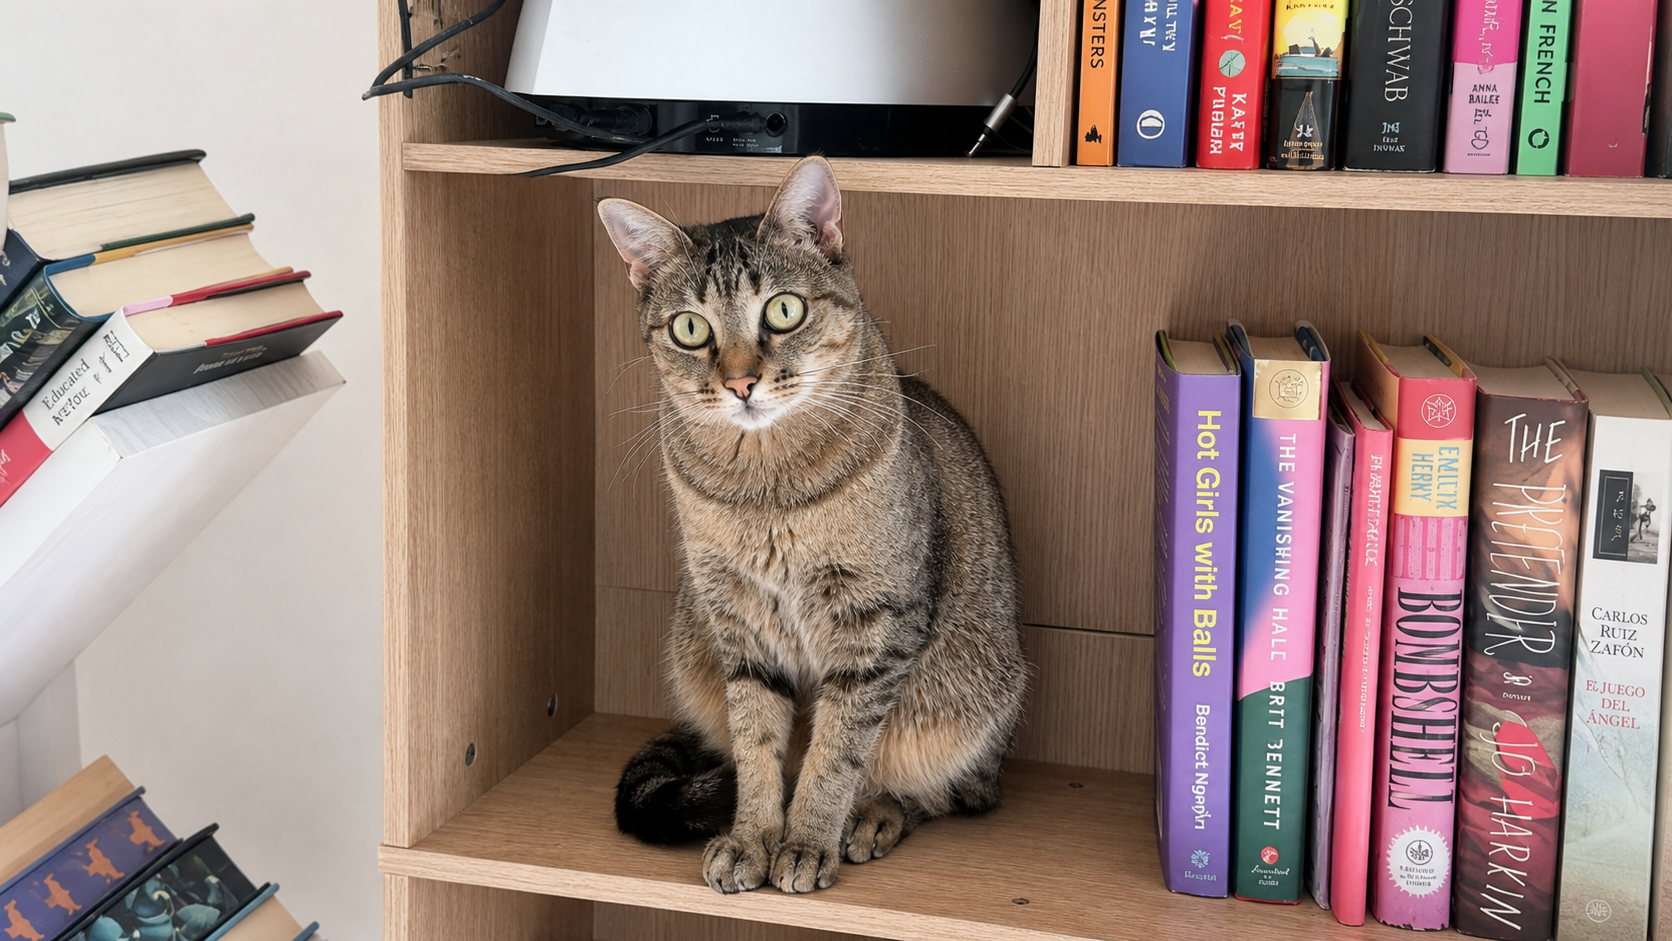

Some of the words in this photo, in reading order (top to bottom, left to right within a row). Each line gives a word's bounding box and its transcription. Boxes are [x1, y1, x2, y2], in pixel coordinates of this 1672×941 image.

[1472, 84, 1498, 93] ANNA
[1534, 24, 1557, 104] FRENCH
[41, 358, 91, 411] Educated
[1196, 410, 1221, 460] Hot
[1278, 433, 1297, 472] THE
[1504, 413, 1566, 464] THE
[1195, 467, 1221, 534] Girls
[1273, 481, 1295, 596] VANISHING
[1194, 541, 1219, 600] with
[1591, 606, 1648, 625] CARLOS
[1600, 624, 1638, 641] RUIZ
[1192, 609, 1217, 677] Balls
[1590, 640, 1645, 658] ZAFÓN
[1599, 681, 1646, 699] JUEGO
[1601, 697, 1630, 712] DEL
[1479, 711, 1538, 776] JO
[1586, 709, 1641, 730] ÁNGEL
[1479, 796, 1533, 931] HARKIN
